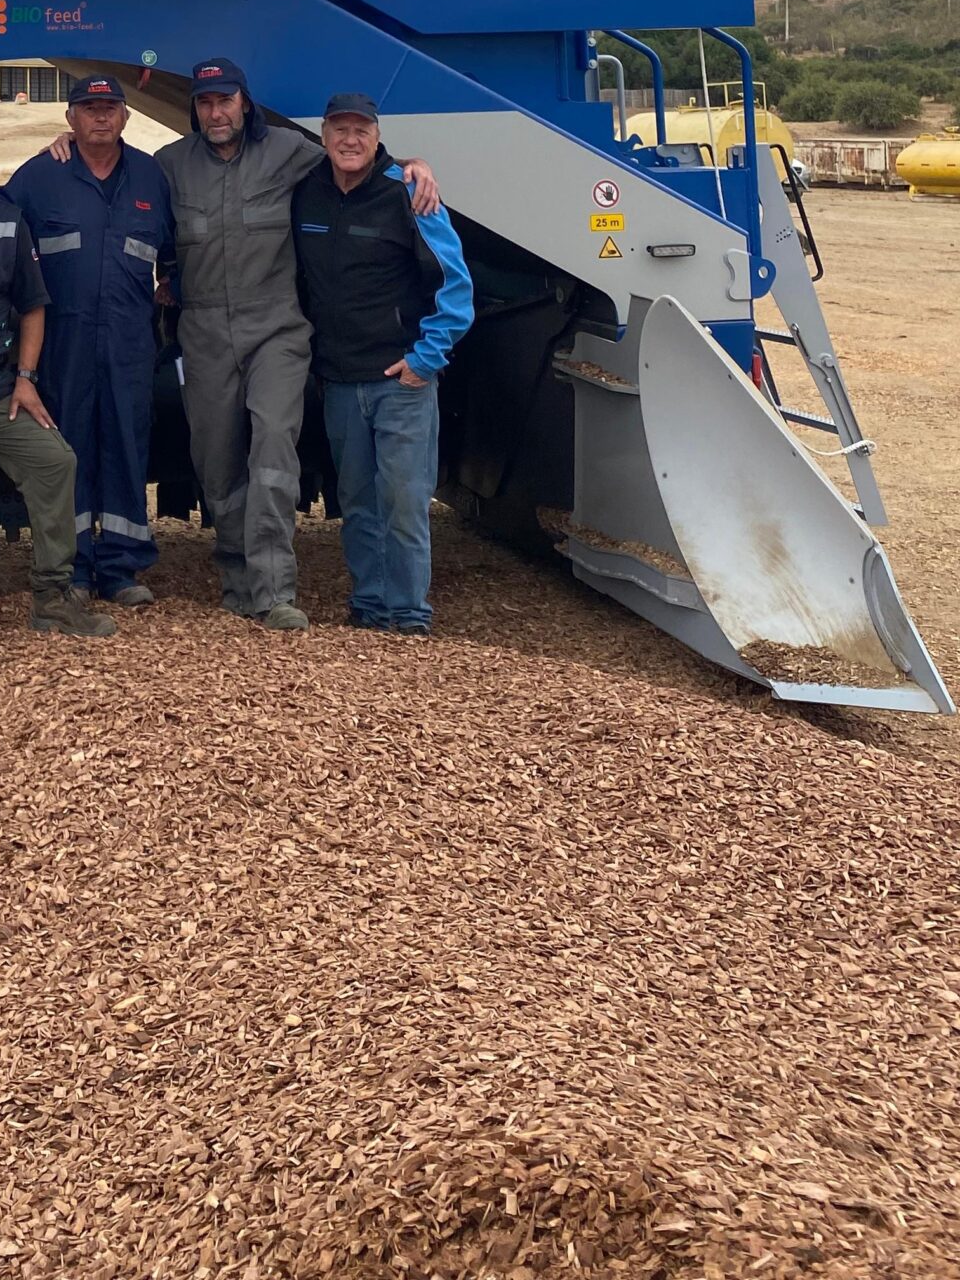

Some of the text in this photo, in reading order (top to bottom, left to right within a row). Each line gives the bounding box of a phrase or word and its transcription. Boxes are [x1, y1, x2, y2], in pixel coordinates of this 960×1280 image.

[44, 8, 81, 23] feed
[595, 218, 620, 228] 25 m
